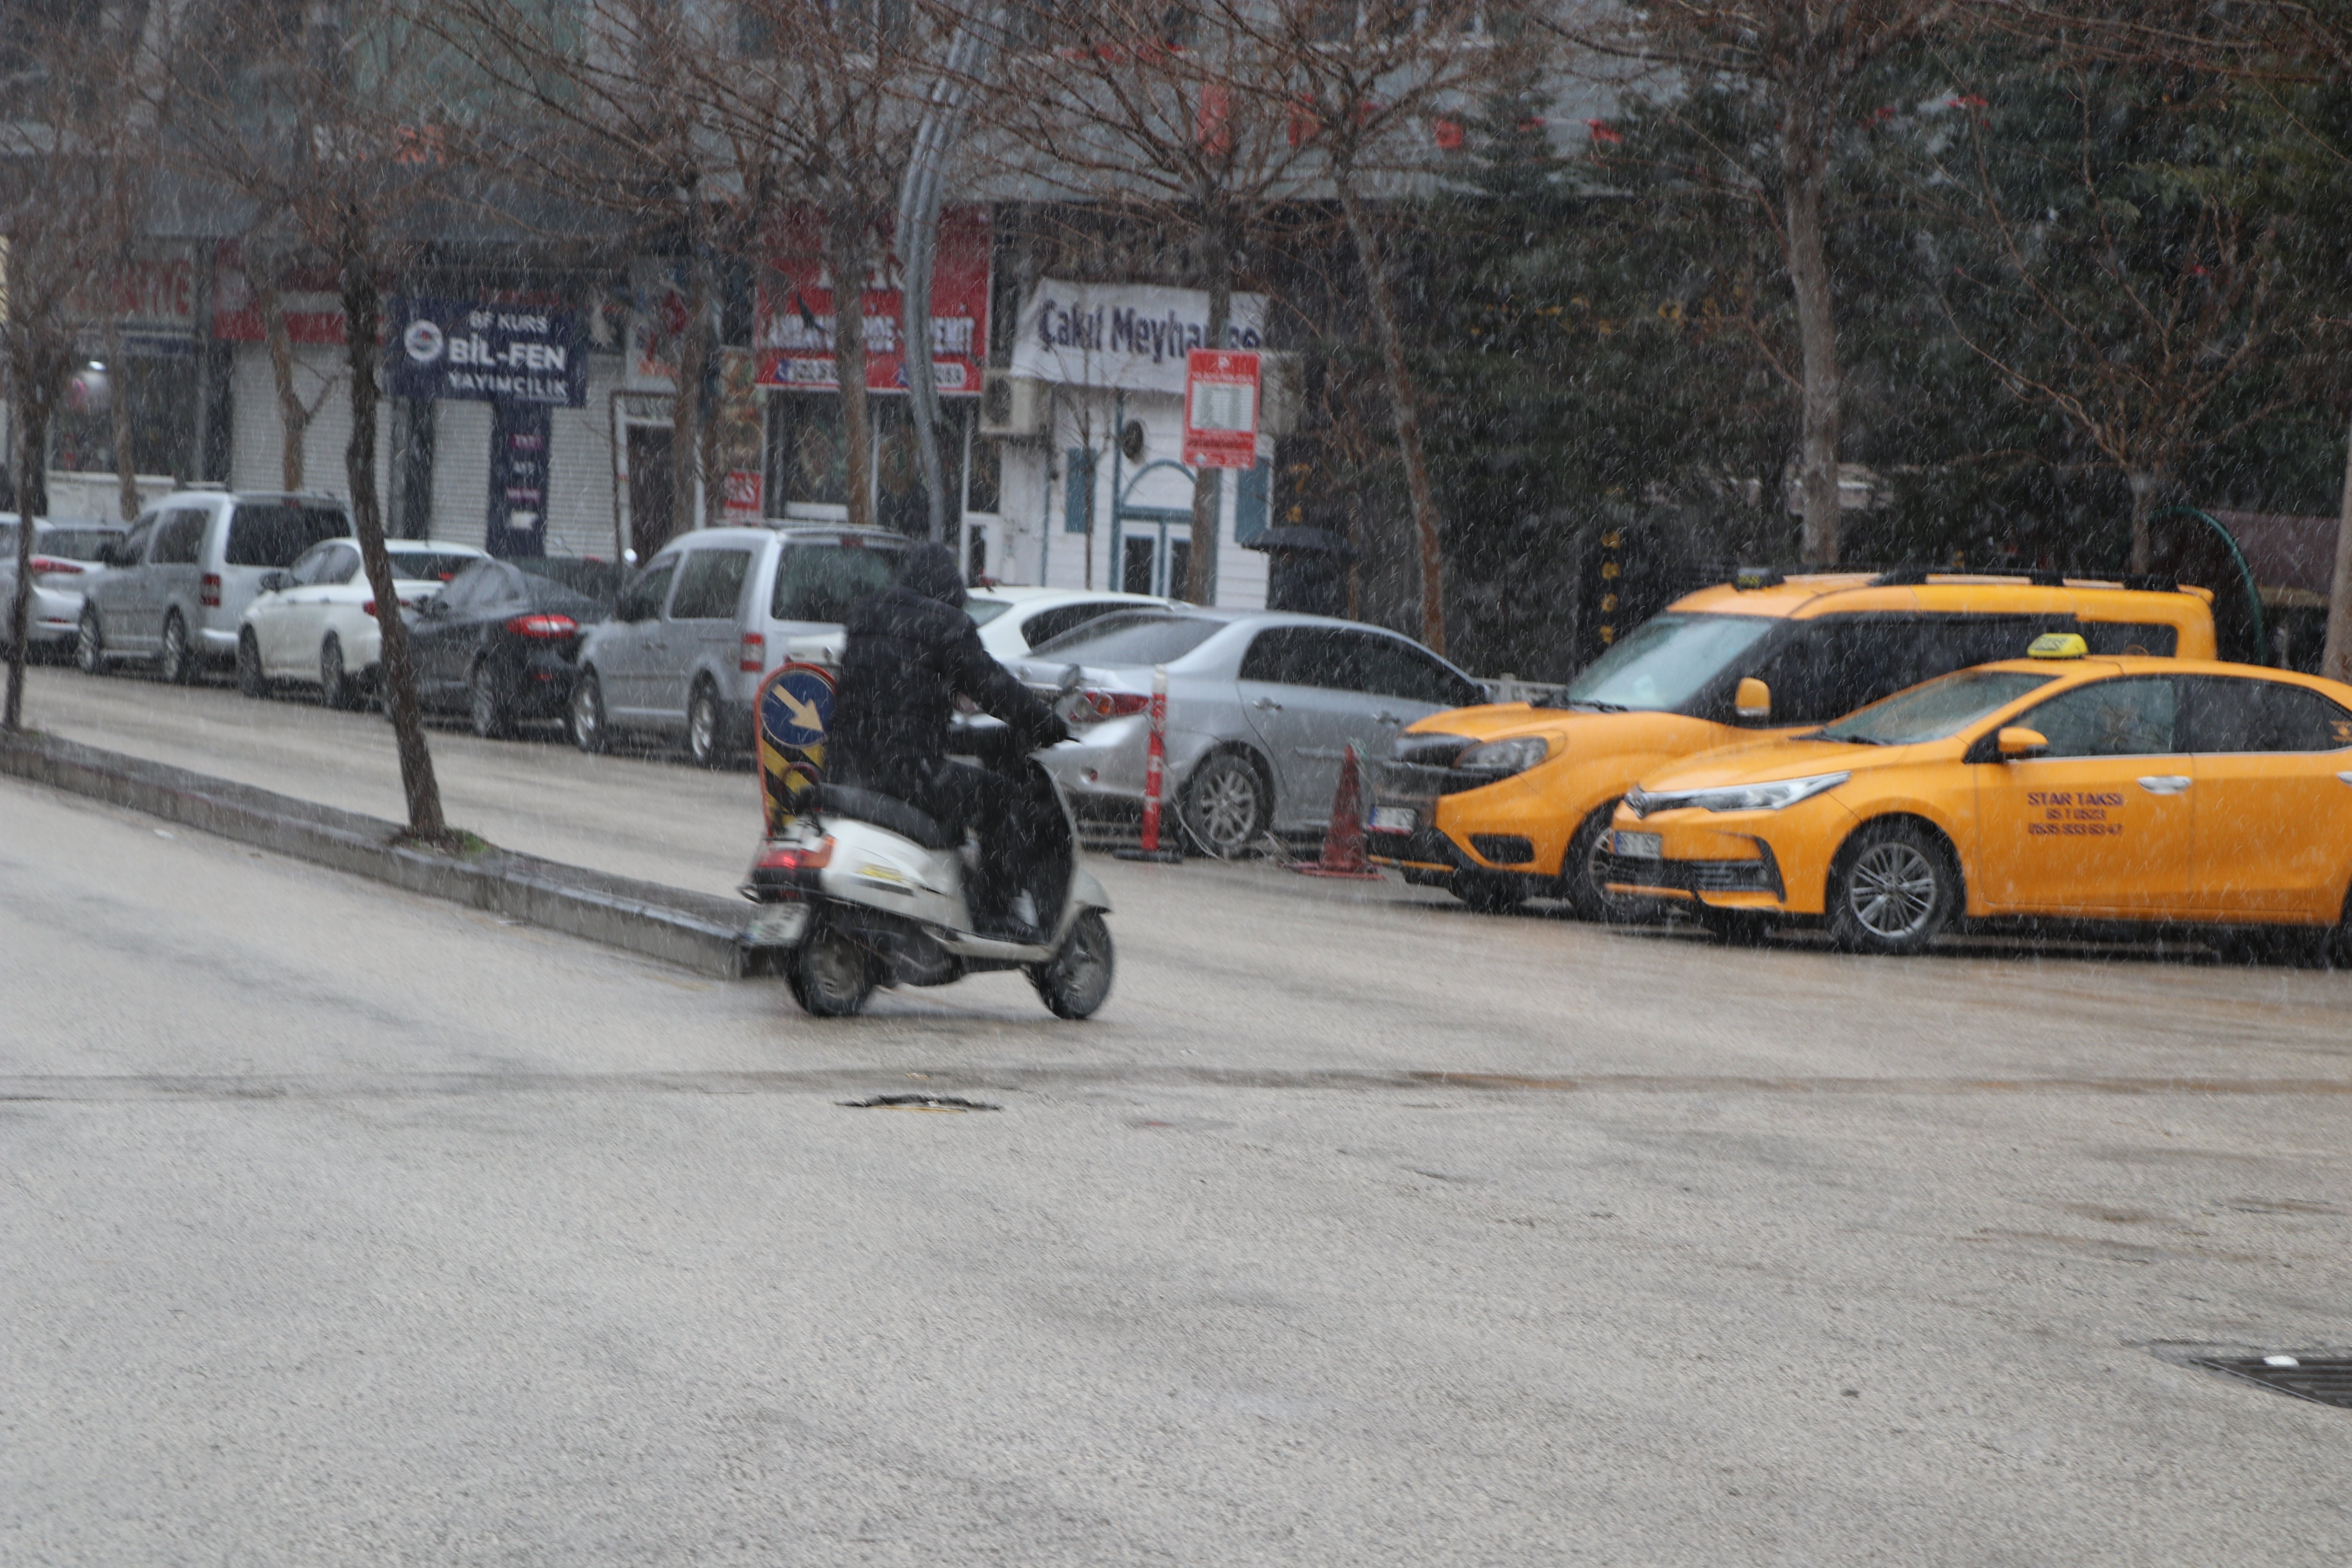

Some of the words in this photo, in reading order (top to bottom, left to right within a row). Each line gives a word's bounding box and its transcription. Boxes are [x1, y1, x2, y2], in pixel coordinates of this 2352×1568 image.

[449, 332, 565, 371] BİL-FEN
[448, 372, 569, 398] YAYINCILIK
[2028, 792, 2072, 806] STAR
